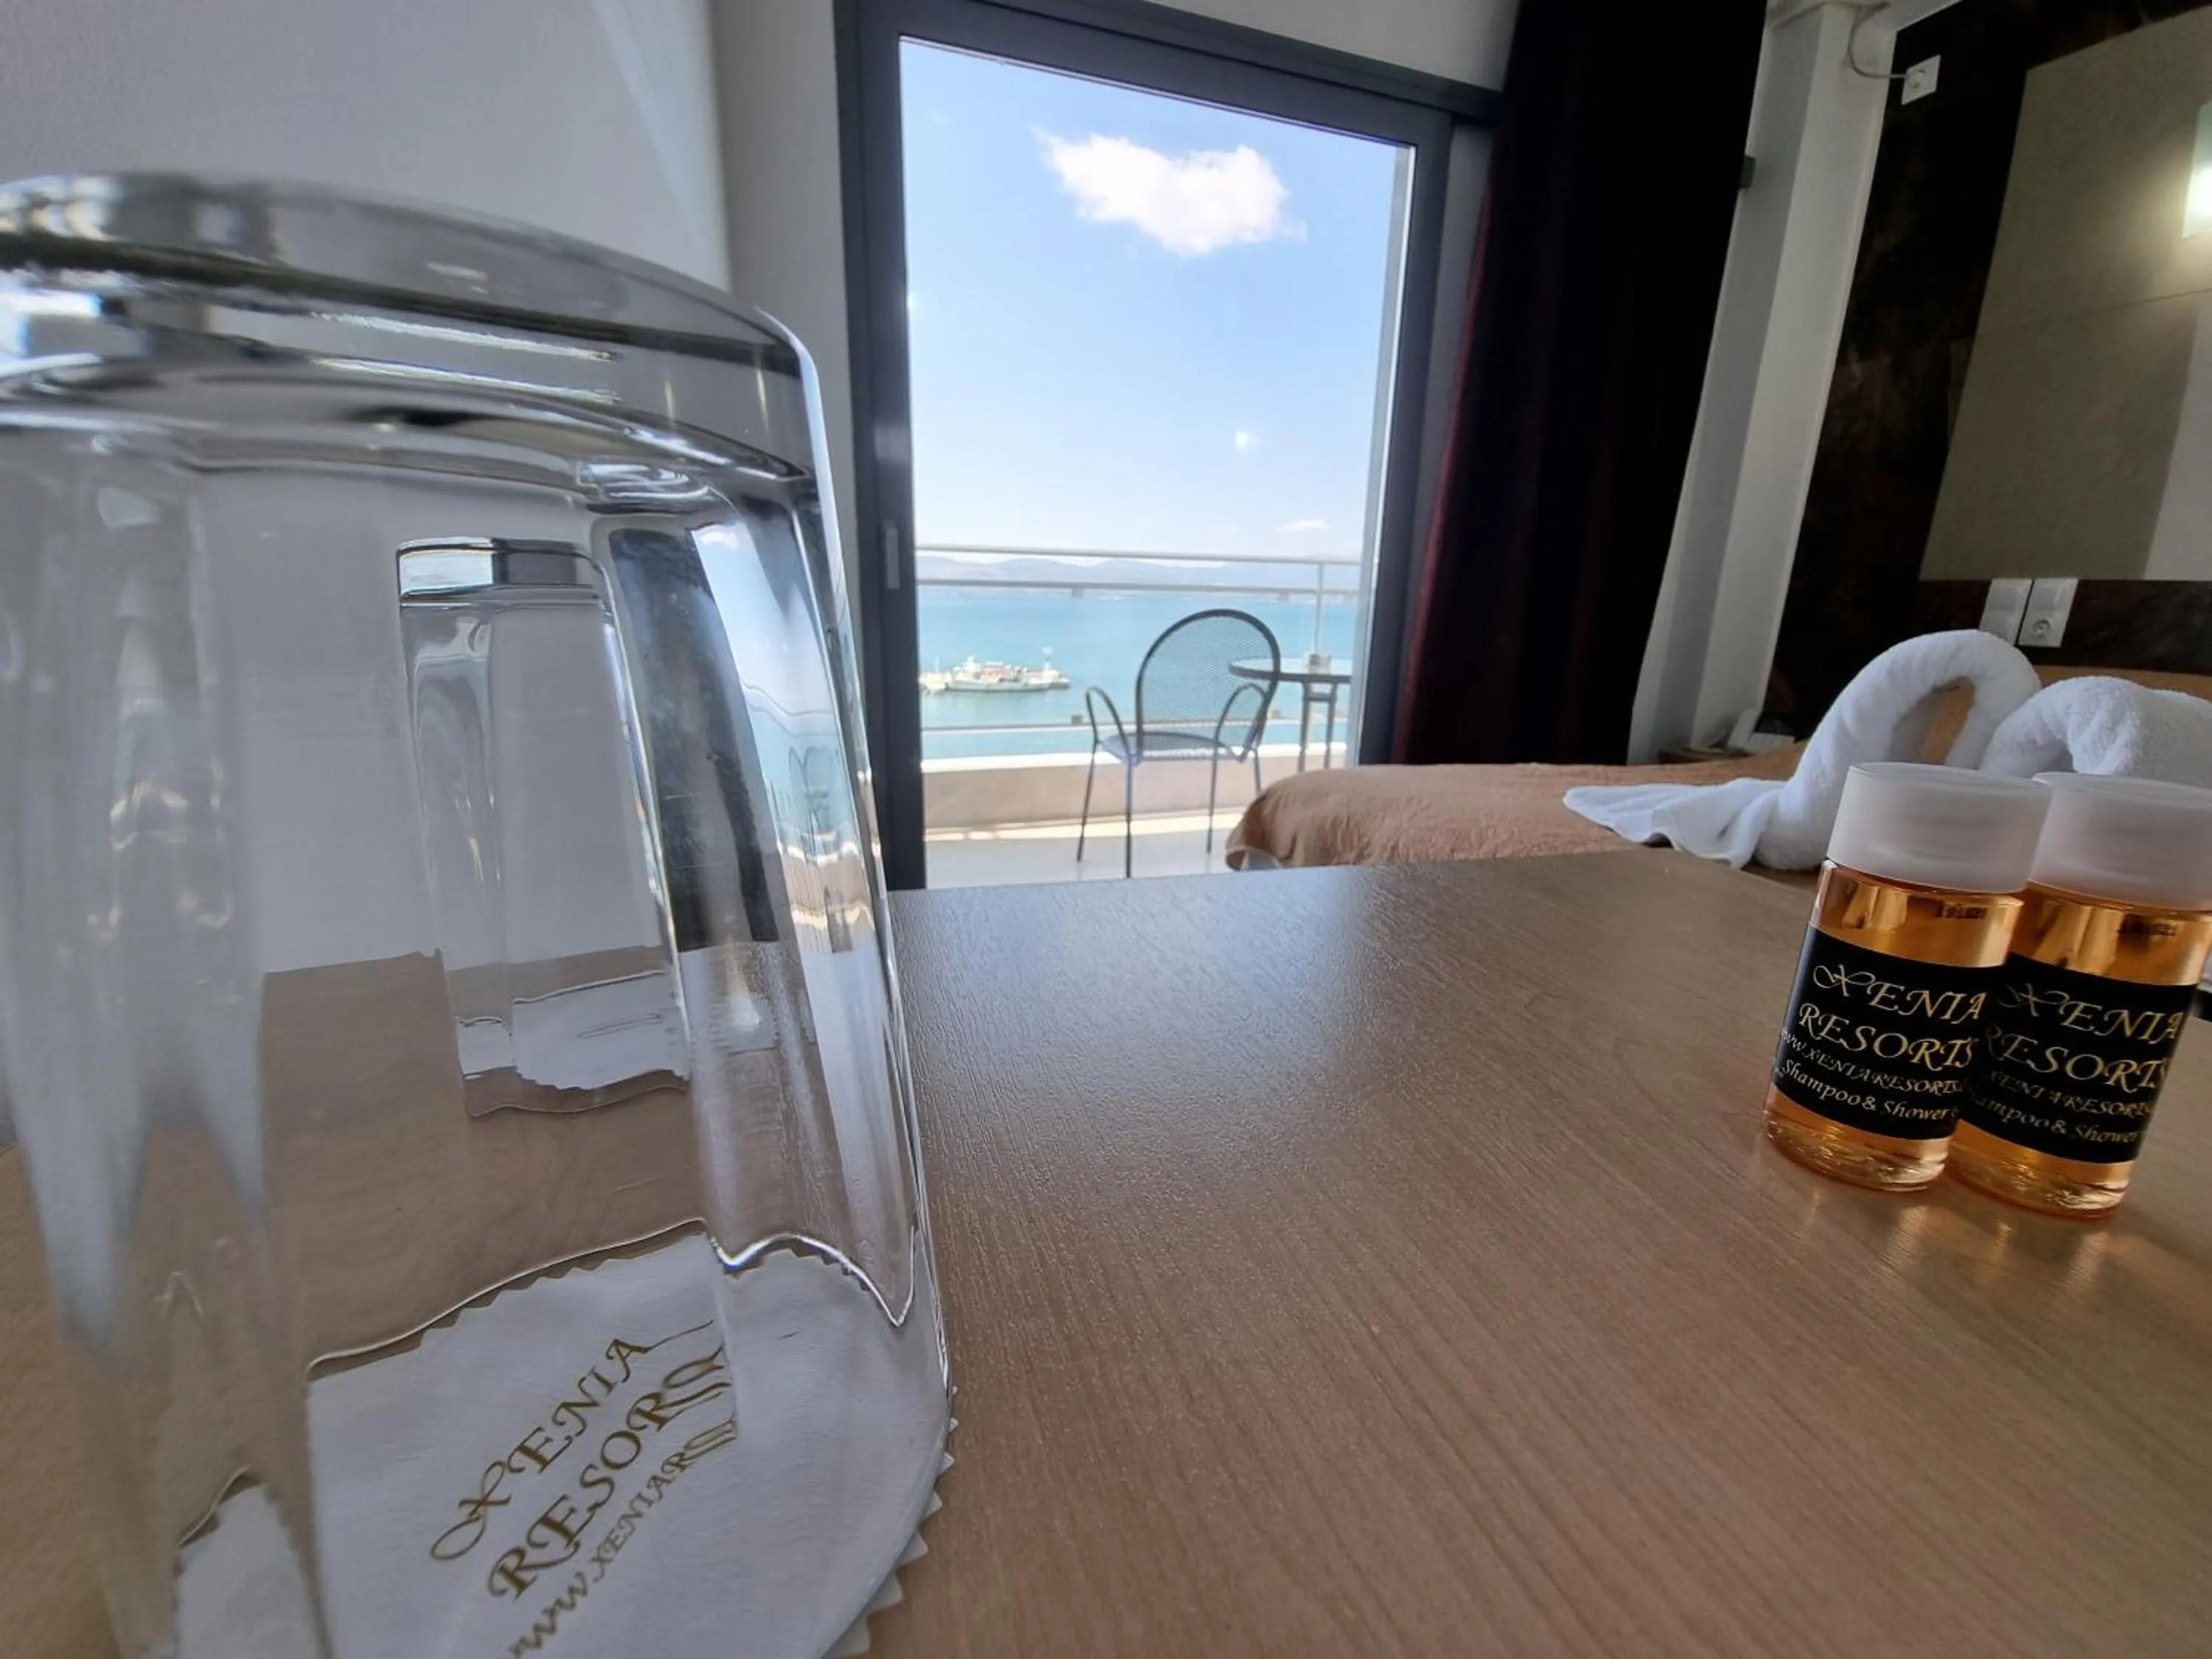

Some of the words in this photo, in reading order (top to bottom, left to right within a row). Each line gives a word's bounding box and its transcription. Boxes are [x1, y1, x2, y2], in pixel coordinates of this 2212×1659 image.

[1813, 964, 1987, 1023] XENIA
[1997, 983, 2185, 1045] XENIA
[1799, 1003, 1979, 1071] RESORTS
